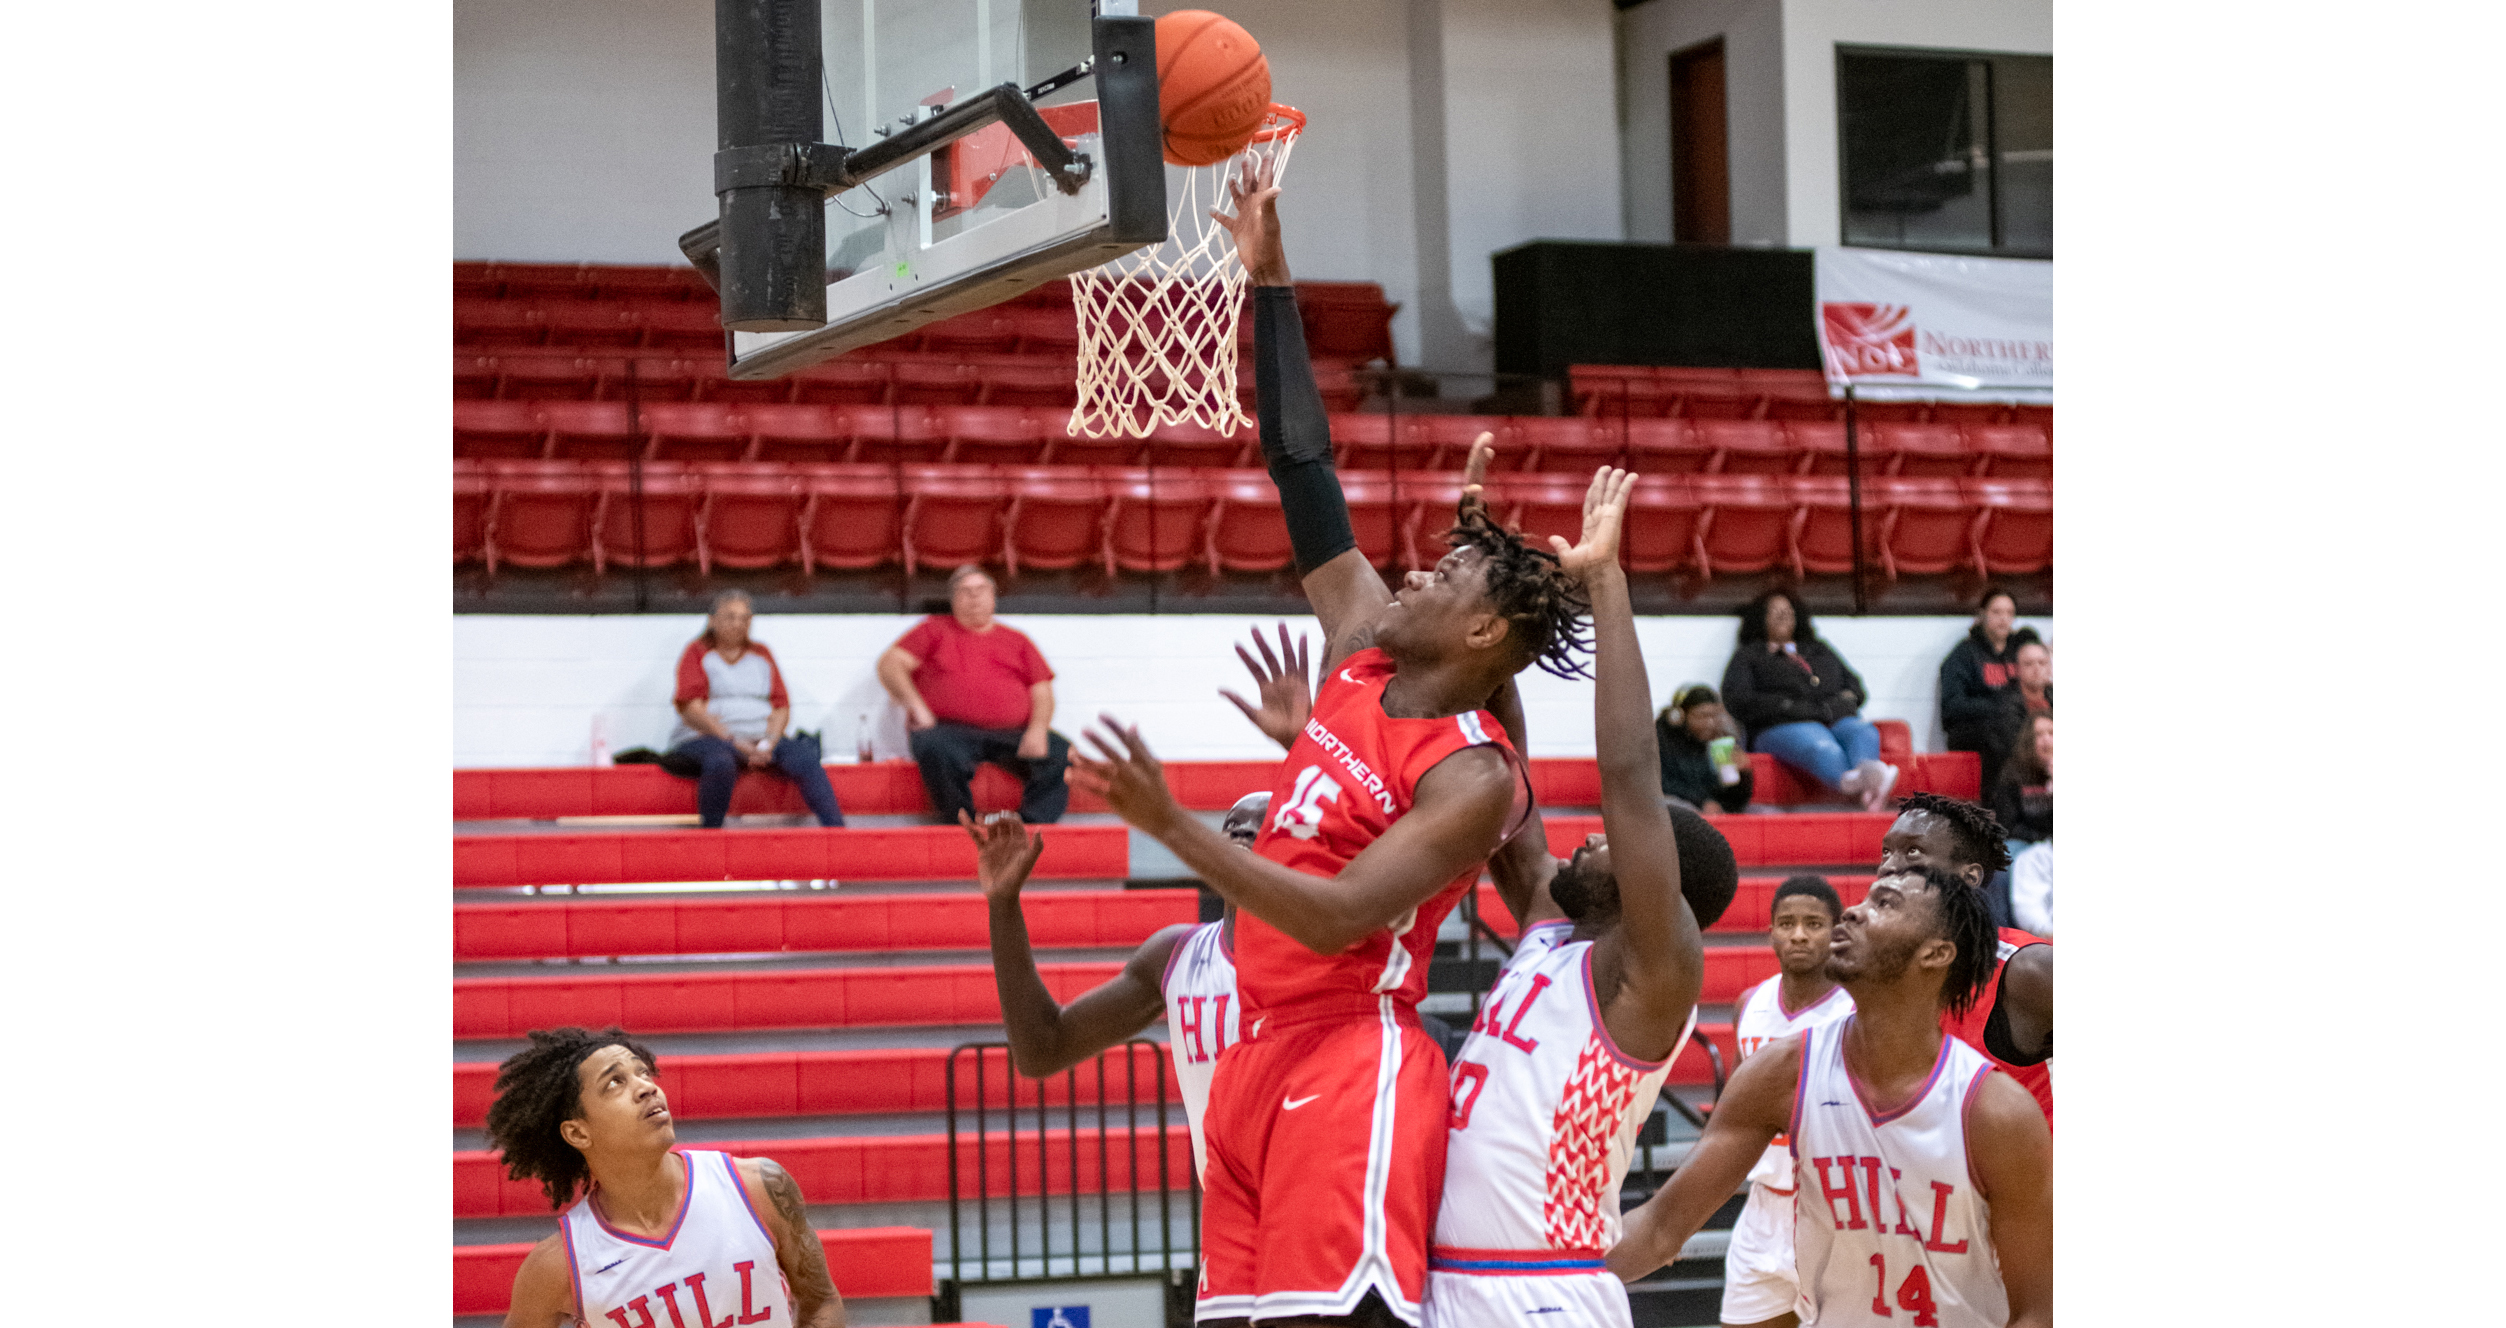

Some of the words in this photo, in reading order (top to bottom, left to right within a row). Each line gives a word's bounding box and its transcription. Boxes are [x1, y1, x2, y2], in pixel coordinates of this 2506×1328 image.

[1923, 329, 2053, 361] NORTHER
[1272, 764, 1343, 840] 15
[1304, 717, 1397, 815] NORTHERN
[1177, 993, 1231, 1065] HI
[1448, 1059, 1490, 1131] 0
[1812, 1155, 1969, 1255] HILL
[1869, 1252, 1939, 1328] 14
